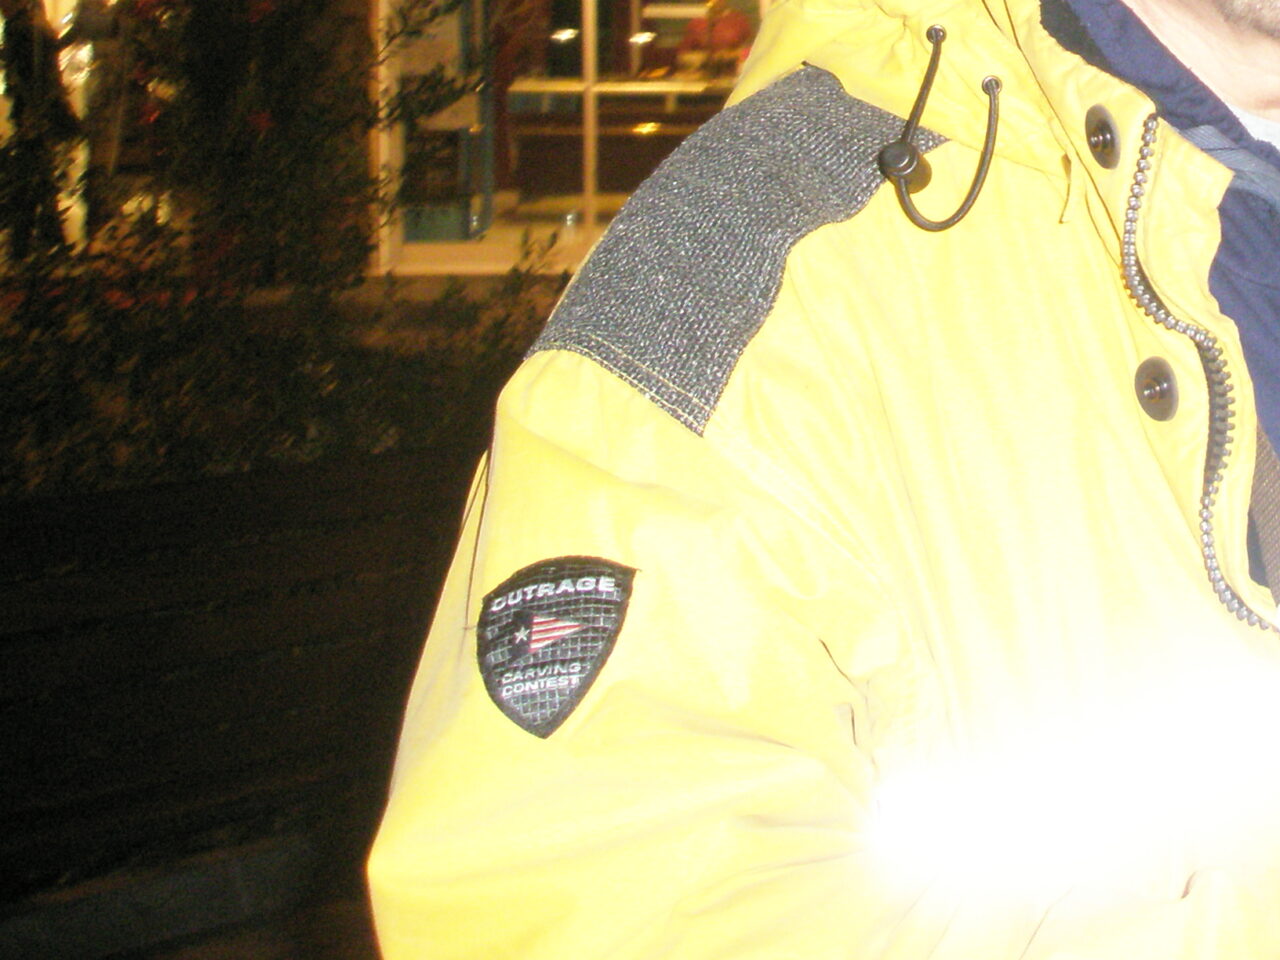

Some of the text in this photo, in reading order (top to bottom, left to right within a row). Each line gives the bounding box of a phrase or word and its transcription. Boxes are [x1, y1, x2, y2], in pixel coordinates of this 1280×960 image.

[490, 576, 616, 611] OUTRAGE
[502, 663, 581, 684] CARVING
[502, 676, 581, 698] CONTEST
